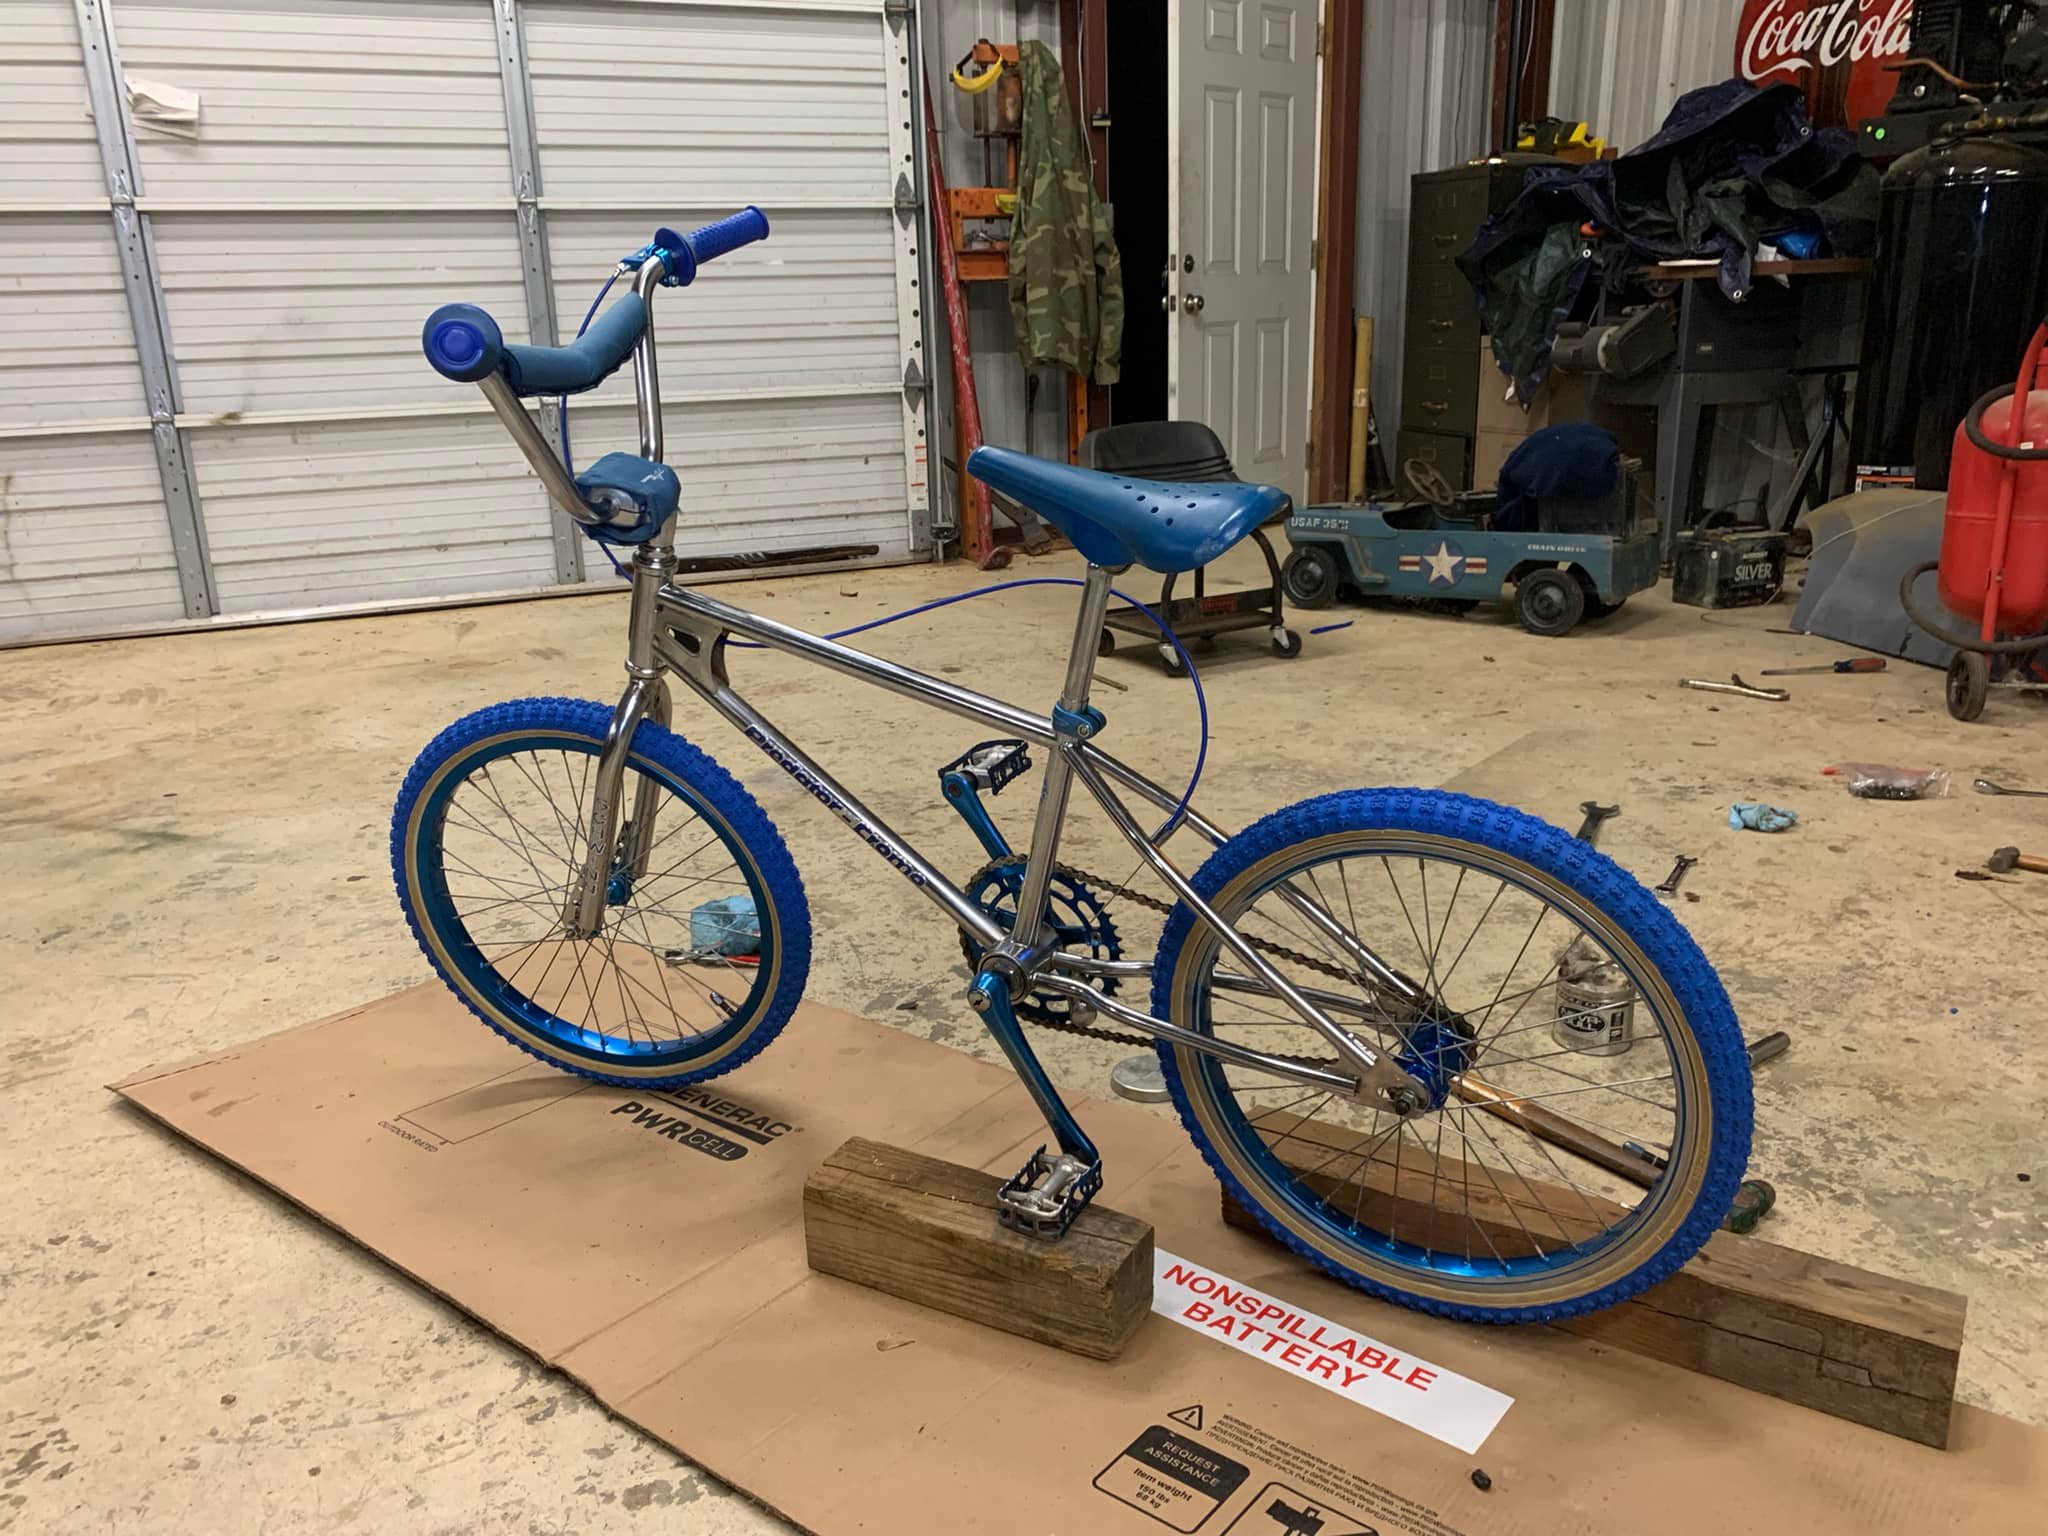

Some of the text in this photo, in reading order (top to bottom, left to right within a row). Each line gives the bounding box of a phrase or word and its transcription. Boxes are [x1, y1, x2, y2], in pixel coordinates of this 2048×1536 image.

[1741, 0, 1912, 81] Coca-Cola
[1291, 516, 1321, 528] USAF
[1734, 562, 1773, 582] SILVER
[671, 1087, 792, 1137] ENERAC
[1163, 1264, 1439, 1392] NONSPILLABLE
[1182, 1301, 1369, 1388] BATTERY
[1144, 1446, 1222, 1488] ASSISTANCE
[1162, 1441, 1221, 1474] REQUEST
[1133, 1467, 1193, 1503] Item weight
[1135, 1490, 1161, 1509] 68 kg
[1138, 1483, 1170, 1504] 150 lbs
